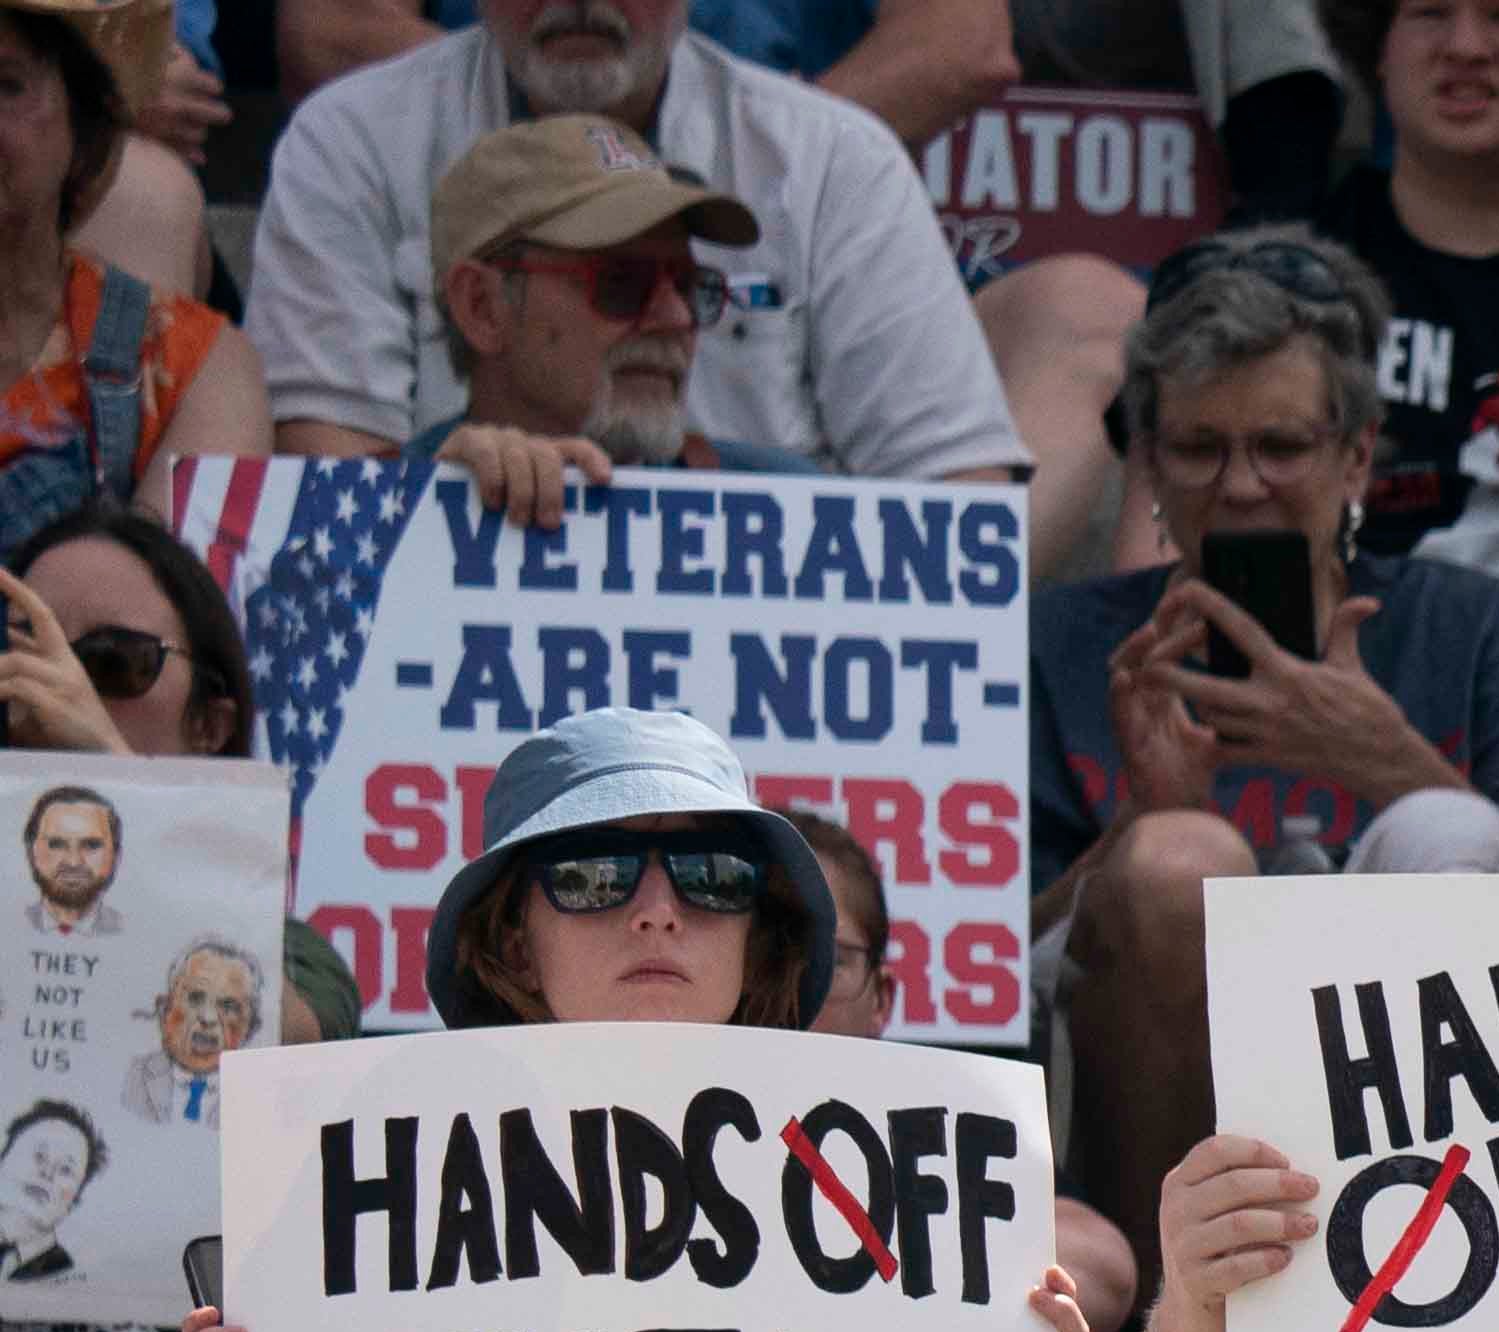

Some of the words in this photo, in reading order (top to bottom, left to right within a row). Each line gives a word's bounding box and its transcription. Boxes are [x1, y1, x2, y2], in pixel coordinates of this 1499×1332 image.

[436, 479, 1020, 607] VETERANS
[29, 950, 100, 977] THEY
[34, 986, 85, 1007] NOT
[23, 1016, 88, 1042] LIKE
[31, 1048, 71, 1073] US
[320, 1087, 761, 1298] HANDS
[778, 1096, 1017, 1305] OFF
